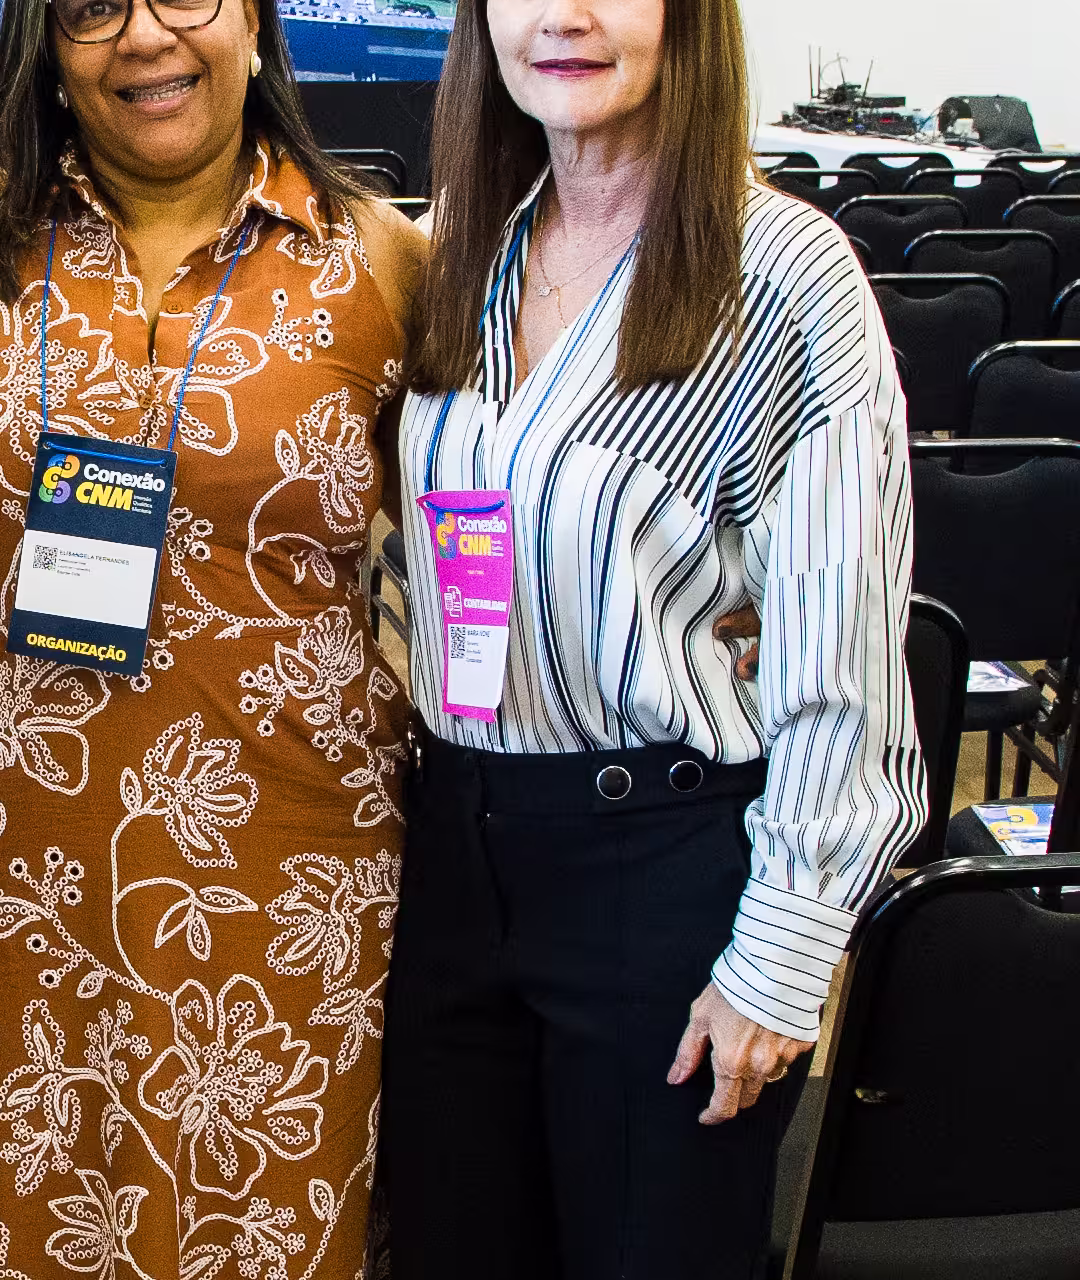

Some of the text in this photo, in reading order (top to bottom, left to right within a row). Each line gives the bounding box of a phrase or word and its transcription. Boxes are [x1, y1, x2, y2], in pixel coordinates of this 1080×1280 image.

[83, 463, 166, 492] Conexão
[75, 481, 134, 511] CNM
[457, 515, 508, 534] Conexão
[458, 533, 492, 557] CNM
[26, 633, 127, 662] ORGANIZAÇÃO
